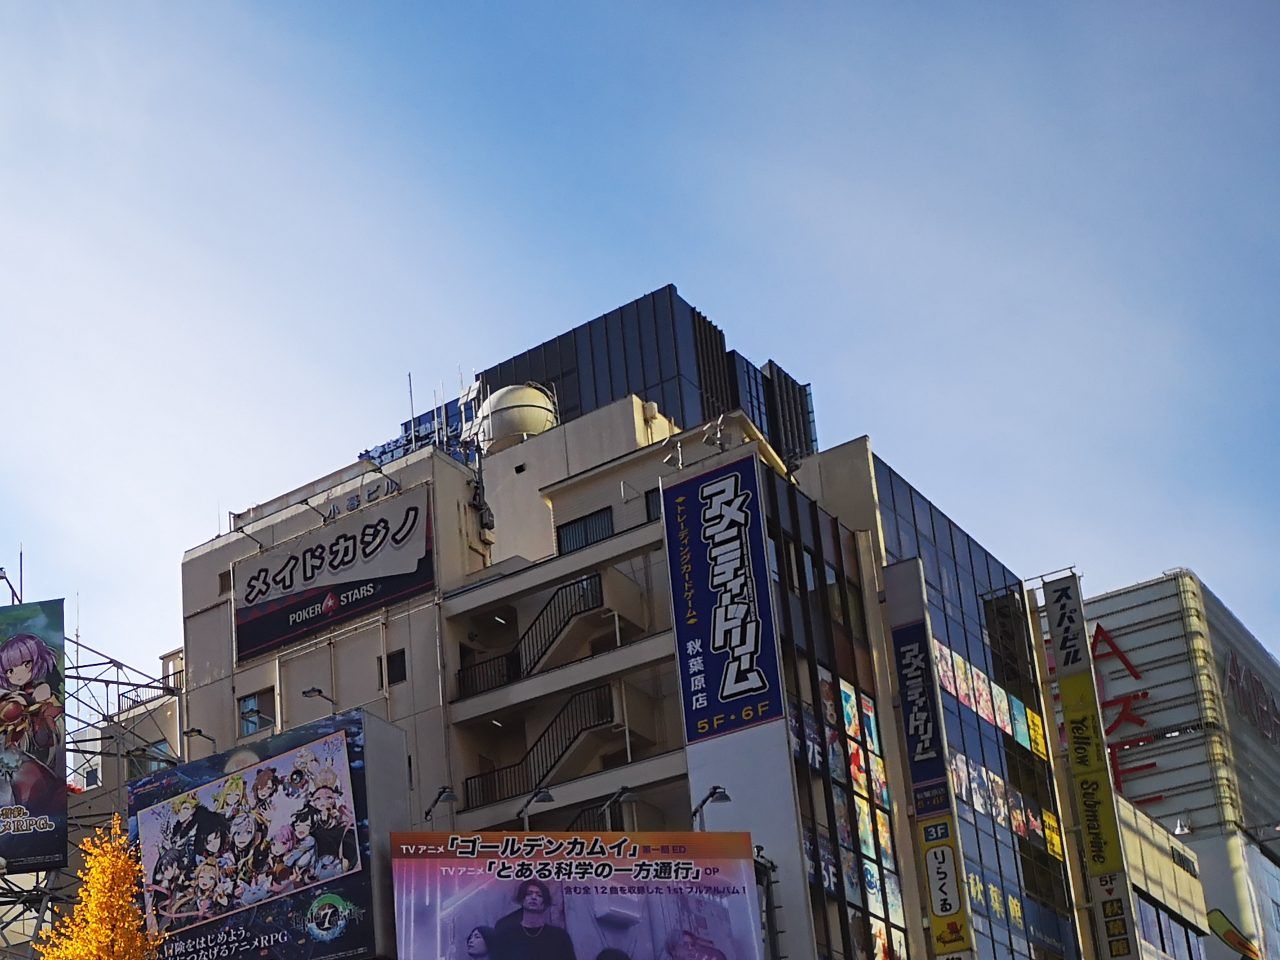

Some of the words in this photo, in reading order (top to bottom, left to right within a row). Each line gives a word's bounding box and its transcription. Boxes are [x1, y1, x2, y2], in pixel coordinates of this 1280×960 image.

[244, 506, 419, 605] メイドカジノ
[676, 503, 698, 617] トレーディングカードゲーム
[289, 606, 321, 626] POKER
[340, 584, 374, 606] STARS
[686, 638, 708, 712] 秋葉原店
[1070, 716, 1091, 767] Yellow
[926, 827, 946, 840] 3F
[1080, 779, 1107, 865] Submarine
[401, 845, 415, 854] TV
[418, 845, 444, 854] アニメ
[448, 836, 639, 858] 「ゴールデンカムイ」
[672, 846, 686, 854] ED
[441, 867, 455, 876] TV
[458, 866, 485, 876] アニメ
[485, 860, 701, 881] 「とある科学の一方通行」
[704, 867, 720, 876] OP
[594, 886, 608, 895] 12
[666, 886, 683, 895] 1st
